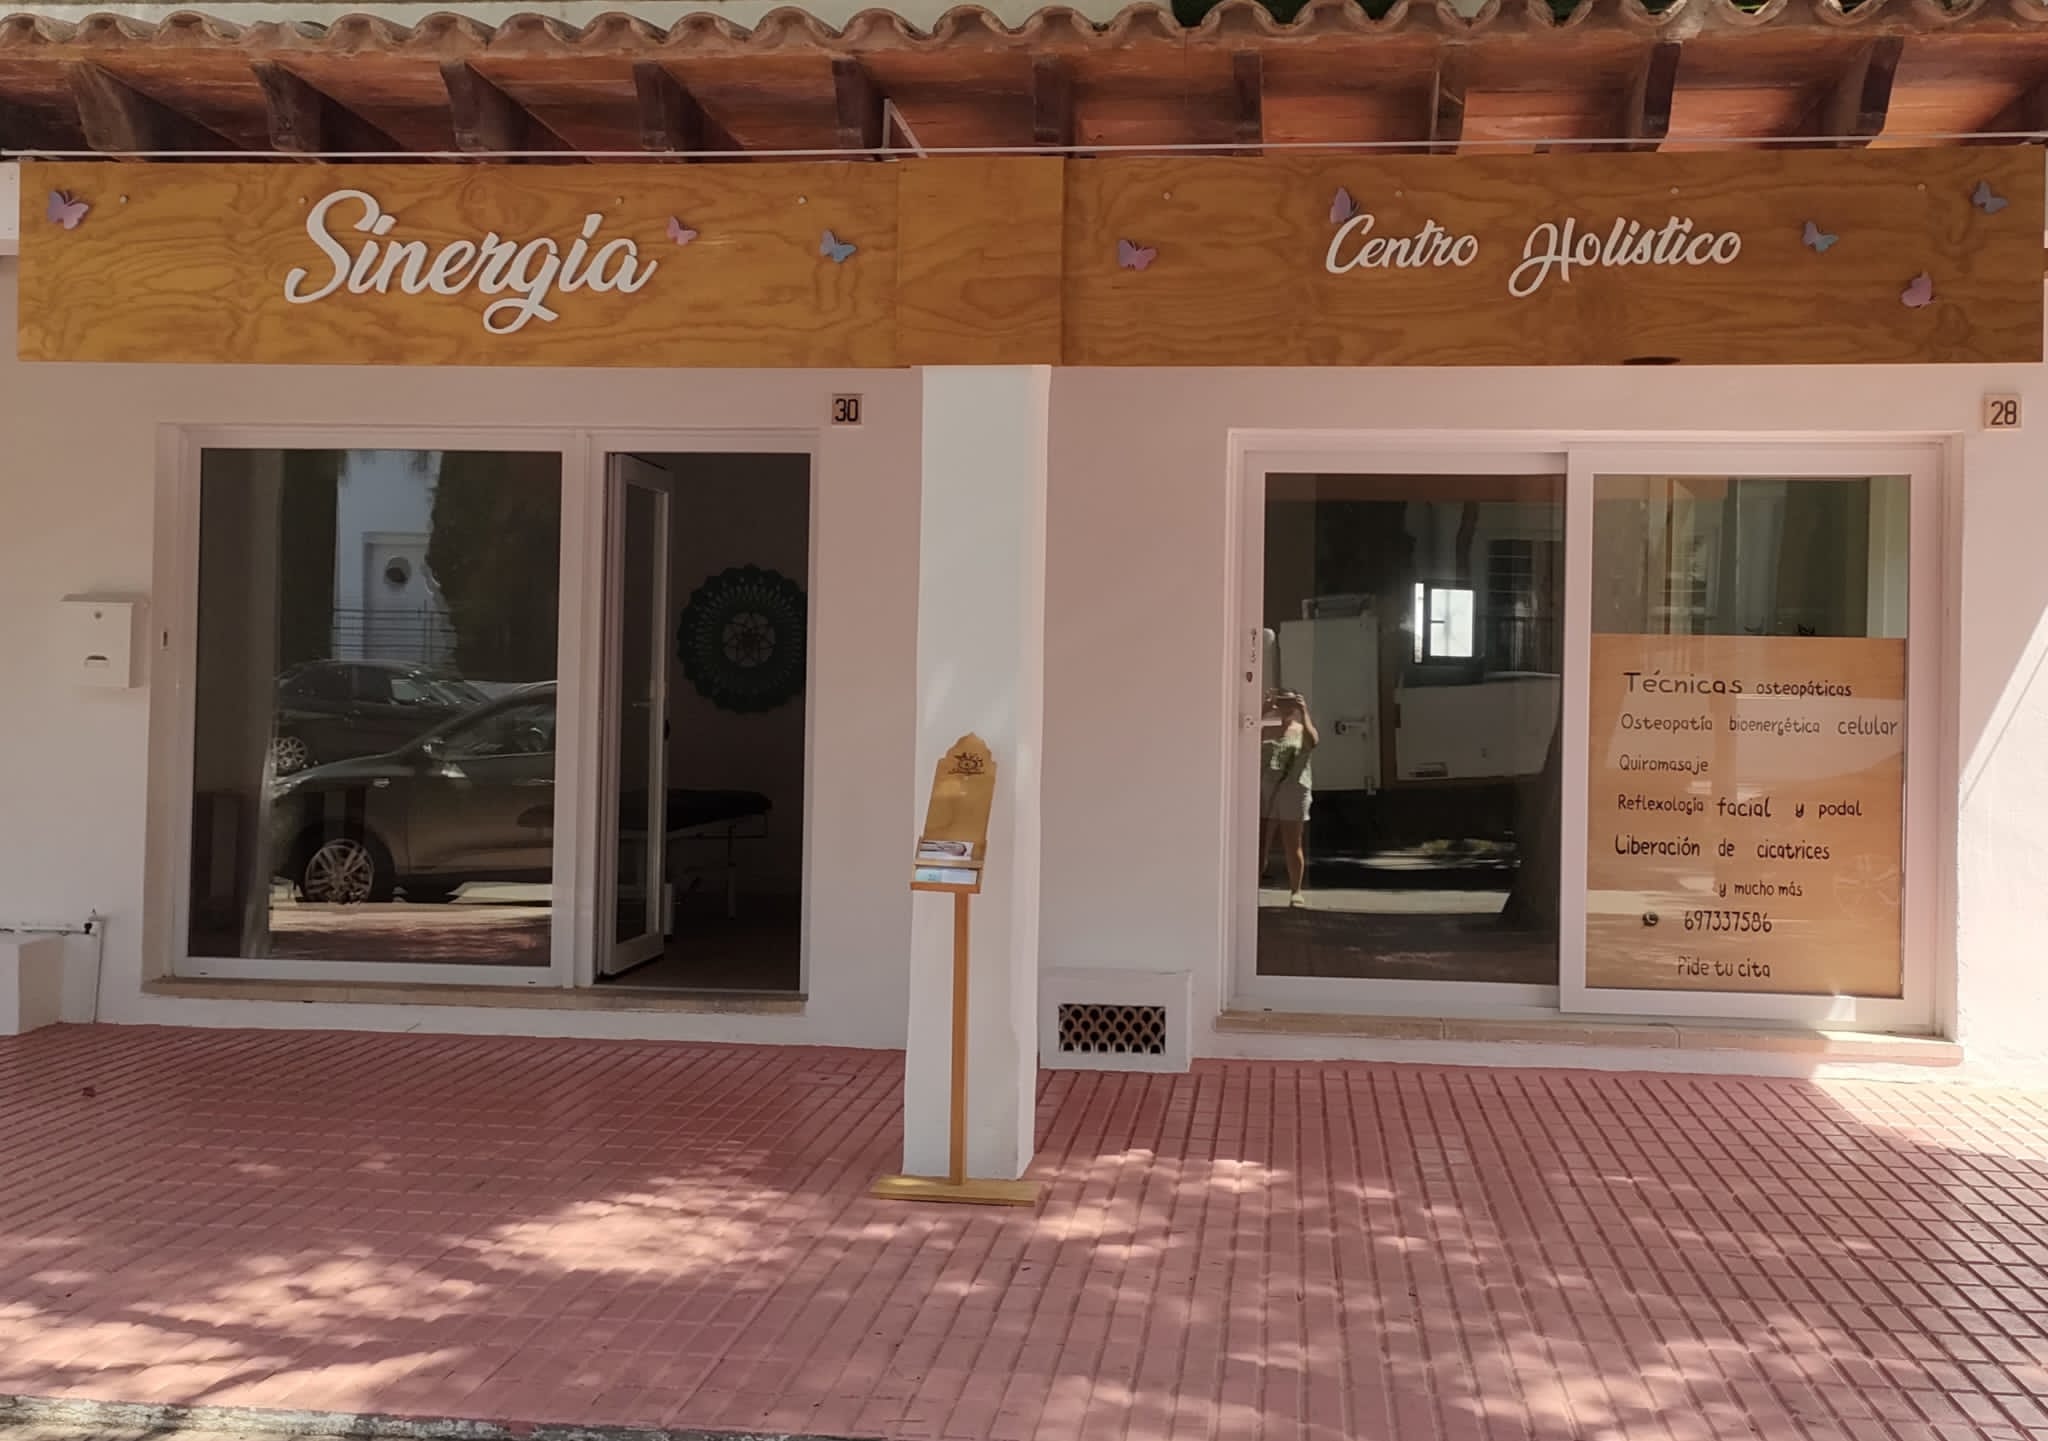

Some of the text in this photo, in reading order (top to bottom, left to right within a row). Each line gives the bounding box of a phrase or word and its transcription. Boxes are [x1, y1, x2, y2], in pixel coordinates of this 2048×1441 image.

[1326, 214, 1742, 298] Centro Holistico
[835, 398, 859, 422] 30
[1991, 400, 2017, 425] 28
[1623, 669, 1853, 698] Técnicas osteopáticas
[1621, 713, 1898, 736] Osteopatía bioenergética celular
[1619, 754, 1709, 775] Quiromasaje
[1617, 793, 1863, 818] Reflexología facial y podal
[1614, 833, 1831, 860] Liberación de cicatrices
[1719, 880, 1803, 897] y mucho más
[1684, 910, 1772, 933] 697337586
[1677, 955, 1771, 978] Pide tu cita
